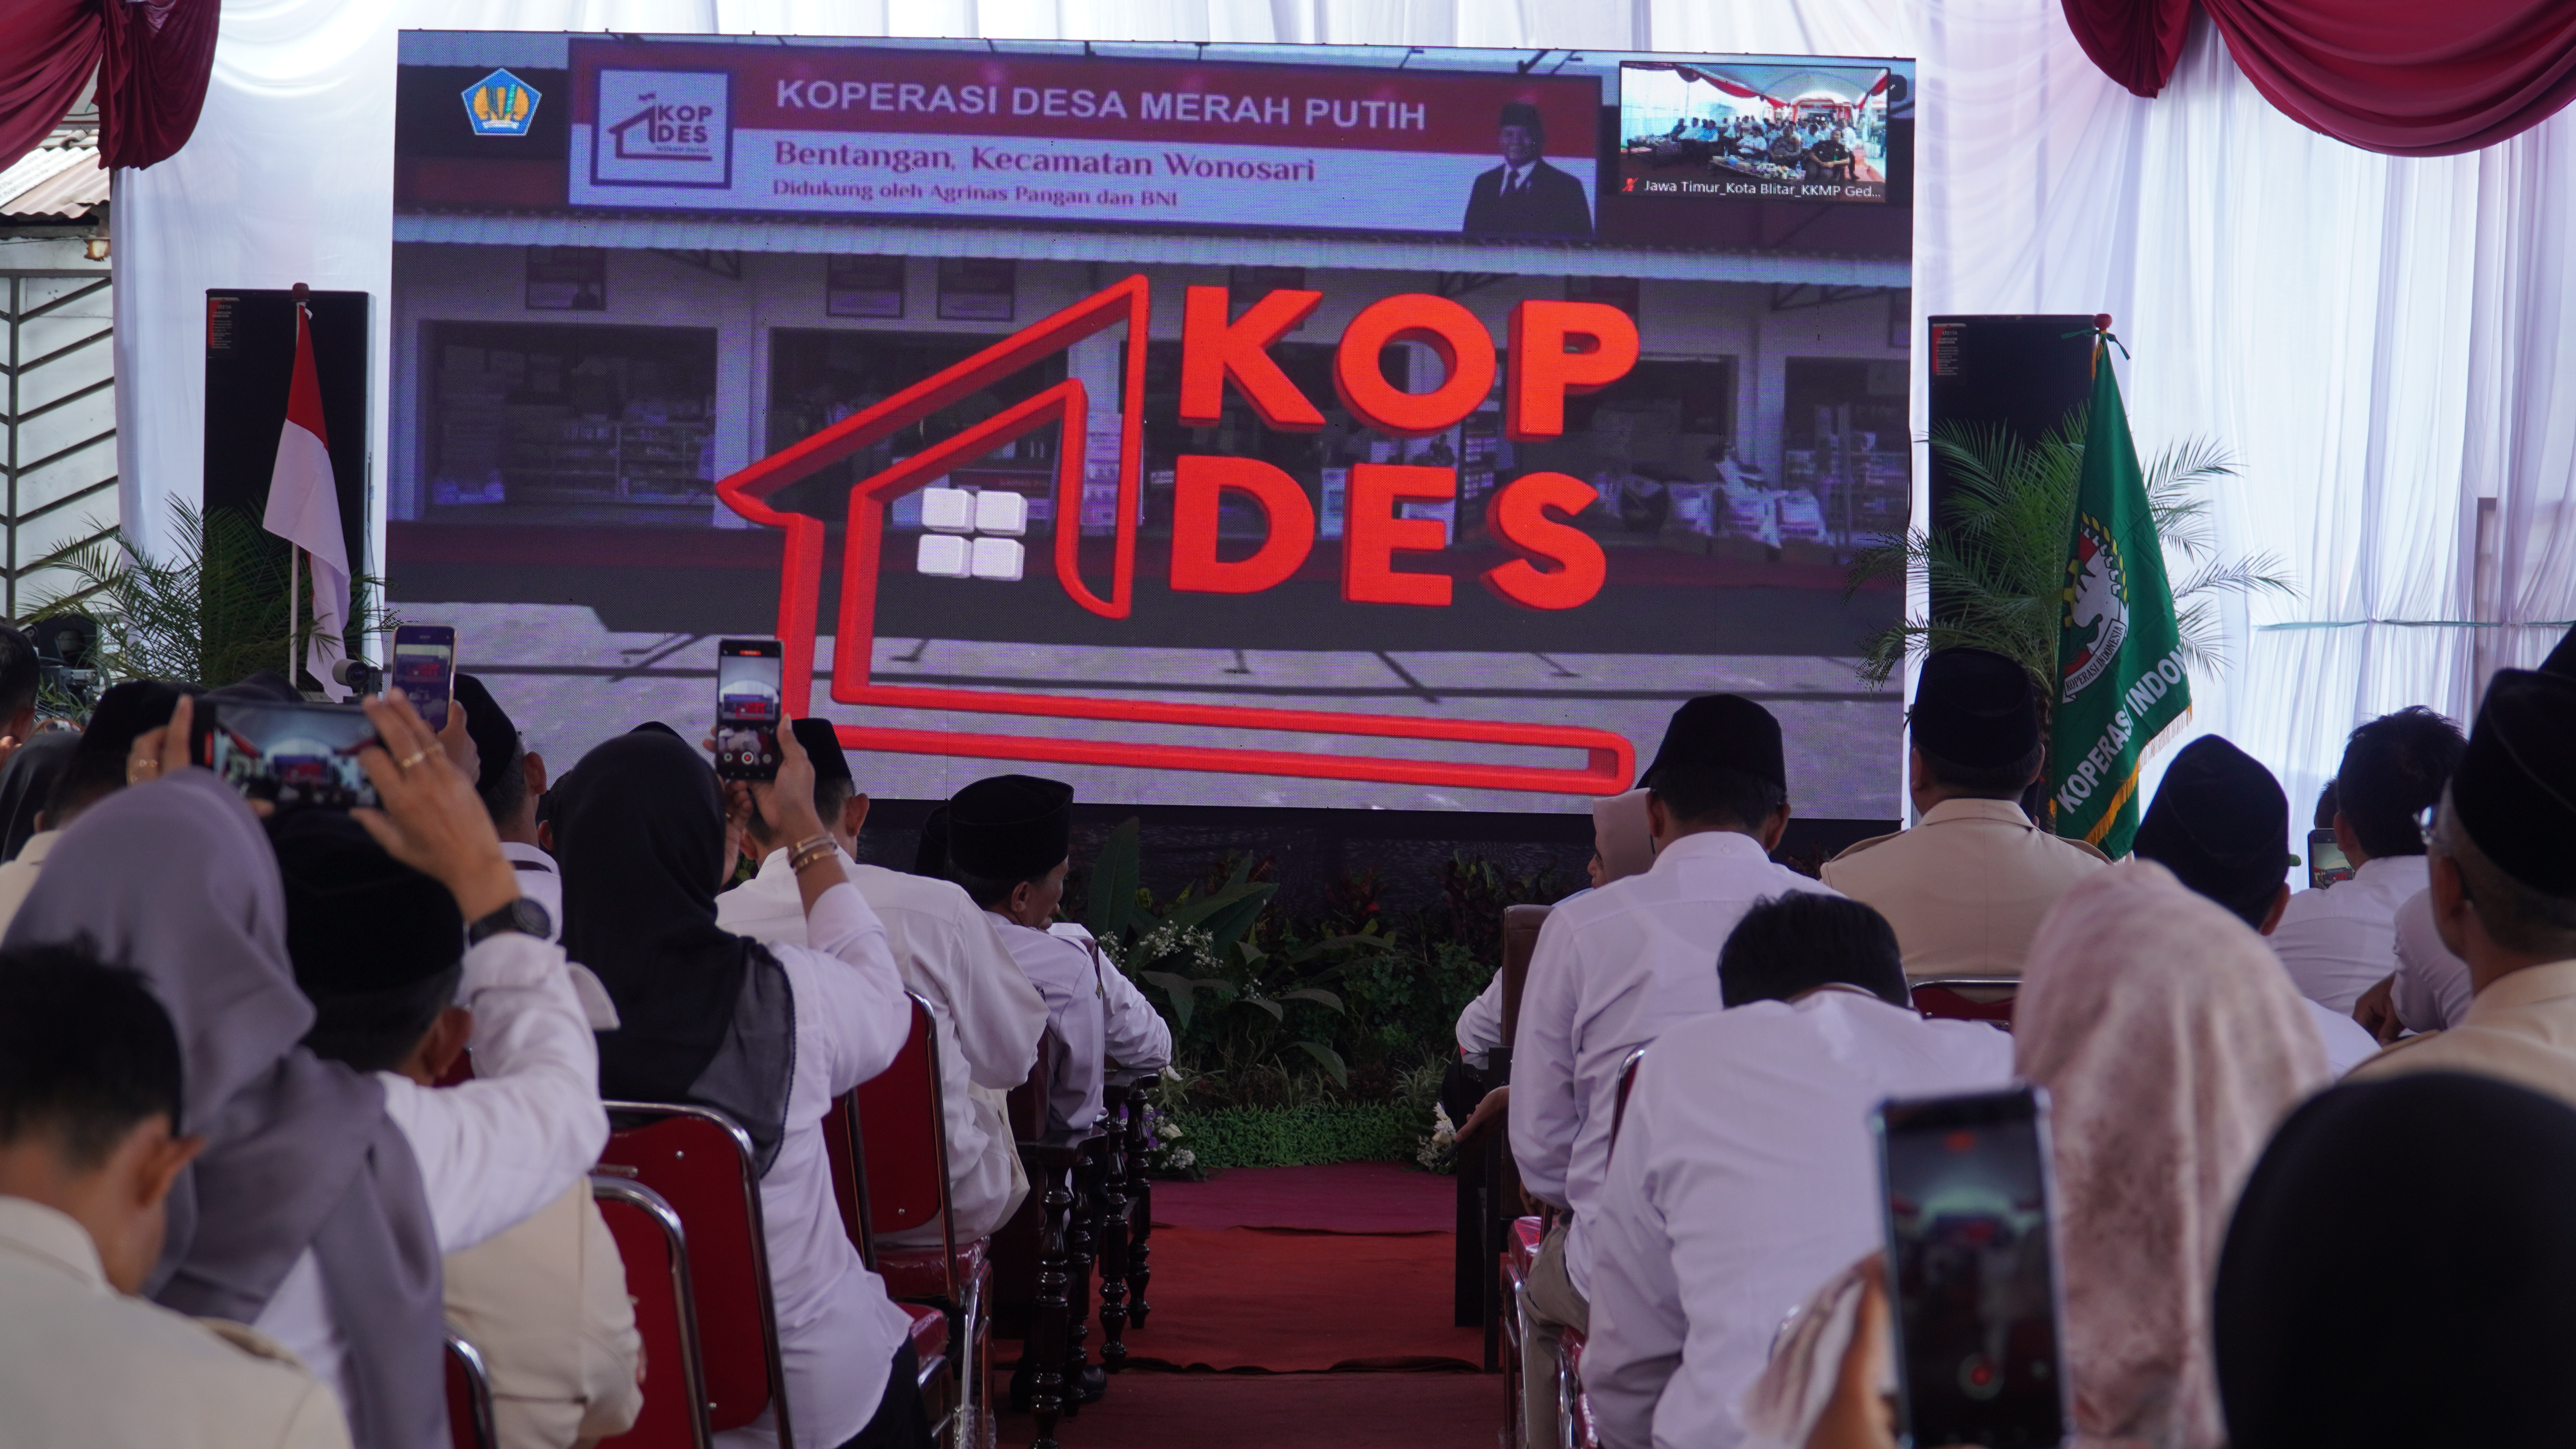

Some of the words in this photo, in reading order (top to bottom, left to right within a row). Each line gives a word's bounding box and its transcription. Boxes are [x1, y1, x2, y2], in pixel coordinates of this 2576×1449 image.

[658, 105, 712, 122] KOP
[776, 79, 997, 114] KOPERASI
[1012, 87, 1127, 119] DESA
[1140, 91, 1290, 124] MERAH
[1305, 98, 1426, 130] PUTIH
[657, 123, 708, 143] DES
[774, 140, 956, 173] Bentangan,
[972, 146, 1152, 176] Kecamatan
[1163, 151, 1315, 181] Wonosari
[773, 179, 873, 201] Didukung
[880, 182, 923, 199] oleh
[930, 185, 1008, 203] Agrinas
[1015, 186, 1090, 206] Pangan
[1097, 191, 1134, 206] dan
[1141, 192, 1178, 206] BNI
[1643, 180, 1677, 191] Jawa
[1681, 180, 1756, 196] Timur_Kota
[1846, 185, 1880, 197] Ged...
[1179, 285, 1640, 443] KOP
[1170, 455, 1607, 610] DES
[2066, 663, 2099, 691] KOPERASI
[2096, 626, 2123, 667] INDONESIA
[2056, 703, 2134, 814] KOPERASI
